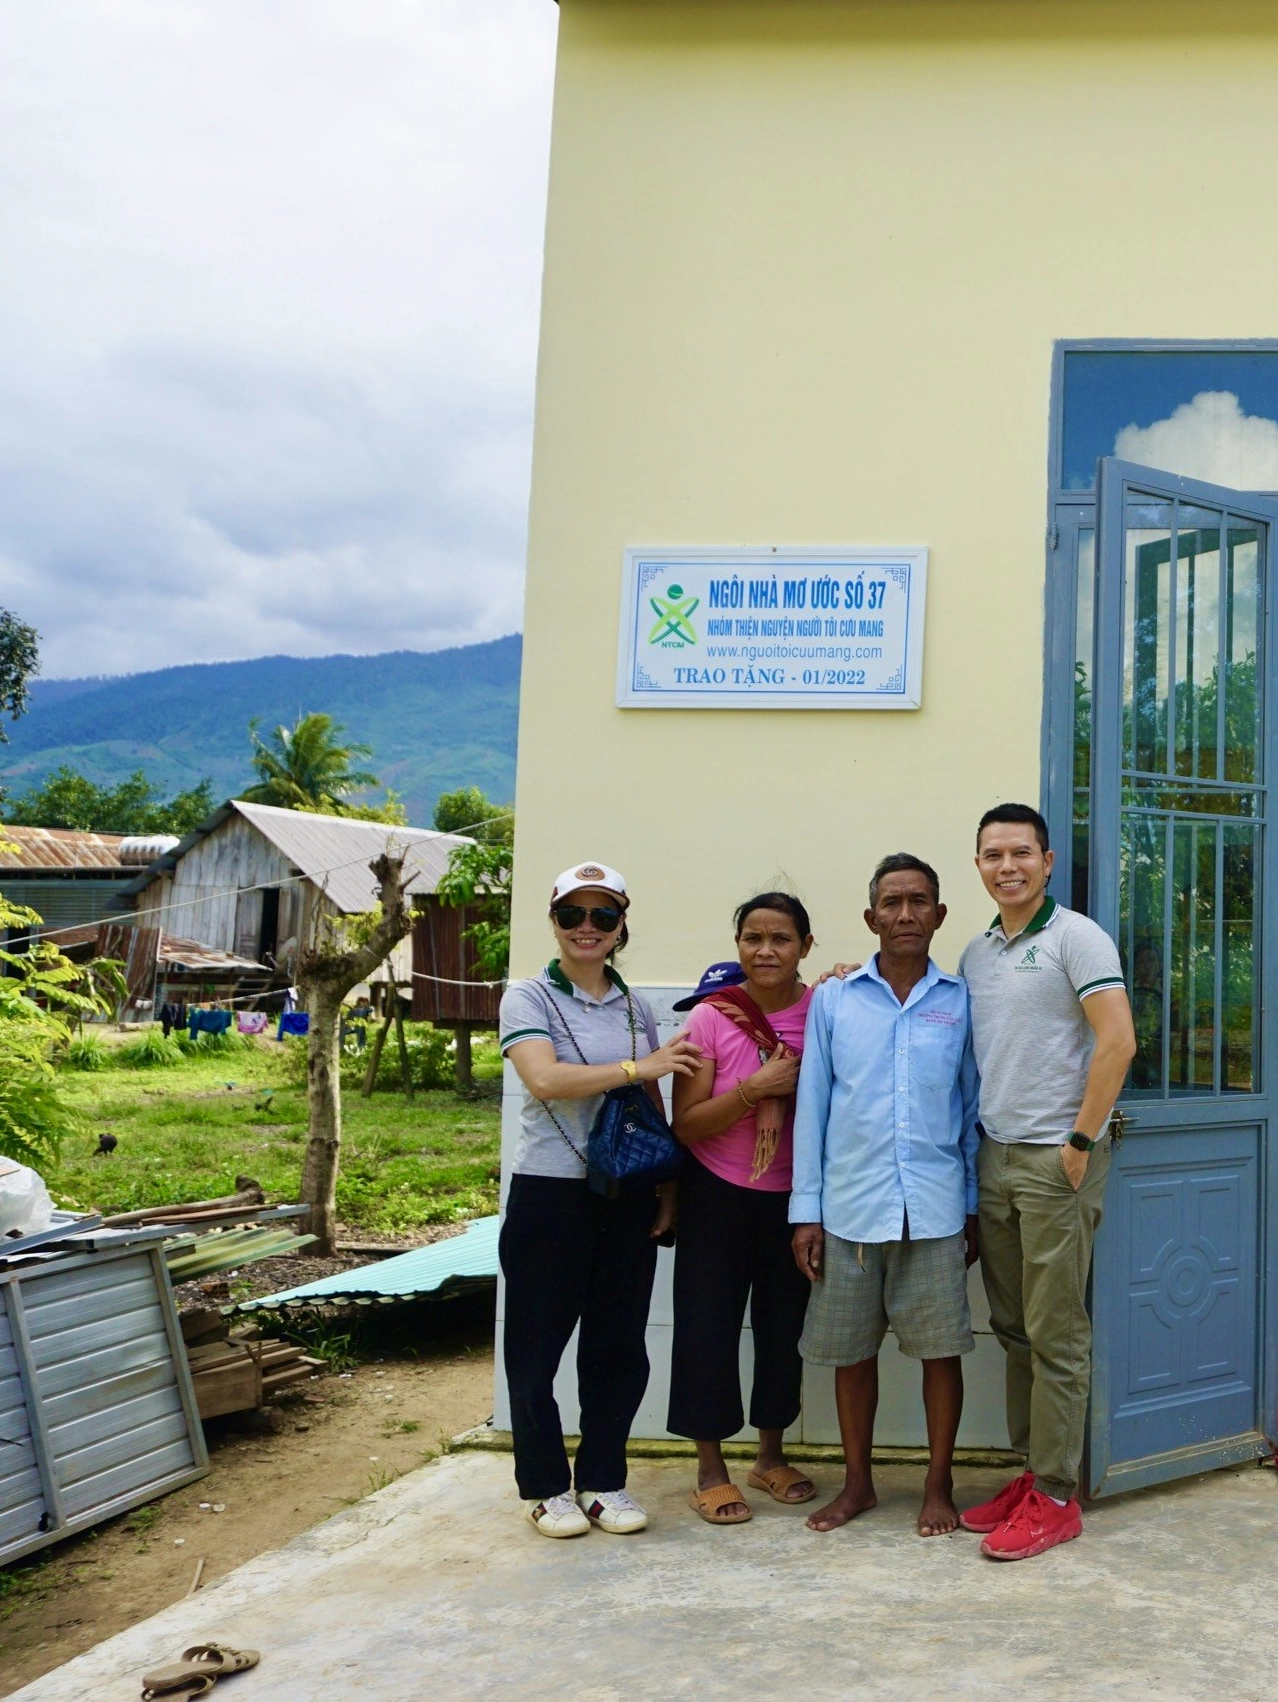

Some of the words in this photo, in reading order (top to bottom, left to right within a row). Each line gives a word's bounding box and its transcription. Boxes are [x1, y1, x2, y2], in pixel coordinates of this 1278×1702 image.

[709, 574, 744, 609] NGÔI
[748, 574, 778, 609] NHÀ
[783, 577, 807, 609] MƠ
[811, 574, 840, 609] ƯỚC
[844, 570, 864, 609] SỐ
[868, 580, 886, 609] 37
[708, 616, 732, 636] NHÓM
[735, 616, 759, 640] THIỆN
[761, 616, 794, 640] NGUYỆN
[796, 615, 822, 637] NGƯỜI
[824, 616, 838, 637] TÔI
[858, 620, 884, 637] MANG
[707, 644, 882, 662] www.nguoitoicuumang.com
[673, 667, 726, 684] TRAO
[731, 664, 785, 688] TẶNG
[802, 669, 865, 685] 01/2022
